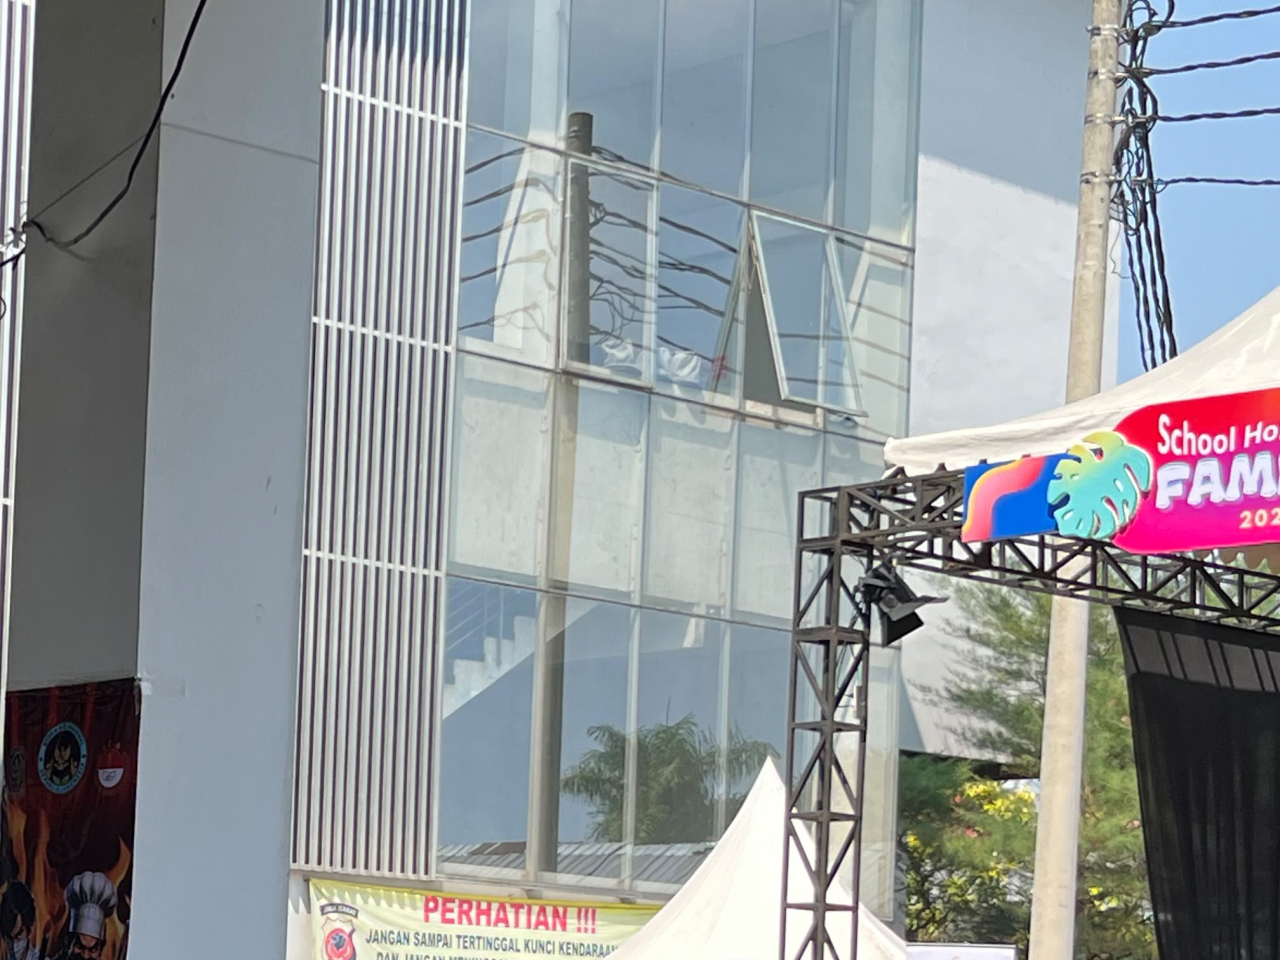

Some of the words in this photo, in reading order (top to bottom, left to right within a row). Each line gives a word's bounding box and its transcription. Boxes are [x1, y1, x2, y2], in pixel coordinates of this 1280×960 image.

[1157, 413, 1235, 455] School
[1243, 421, 1280, 449] Ho
[1155, 450, 1280, 510] FAM
[423, 895, 568, 932] PERHATIAN
[576, 908, 597, 934] !!!
[365, 929, 410, 947] JANGAN
[414, 932, 452, 949] SAMPAI
[456, 934, 521, 953] TERTINGGAL
[524, 939, 555, 955] KUNCI
